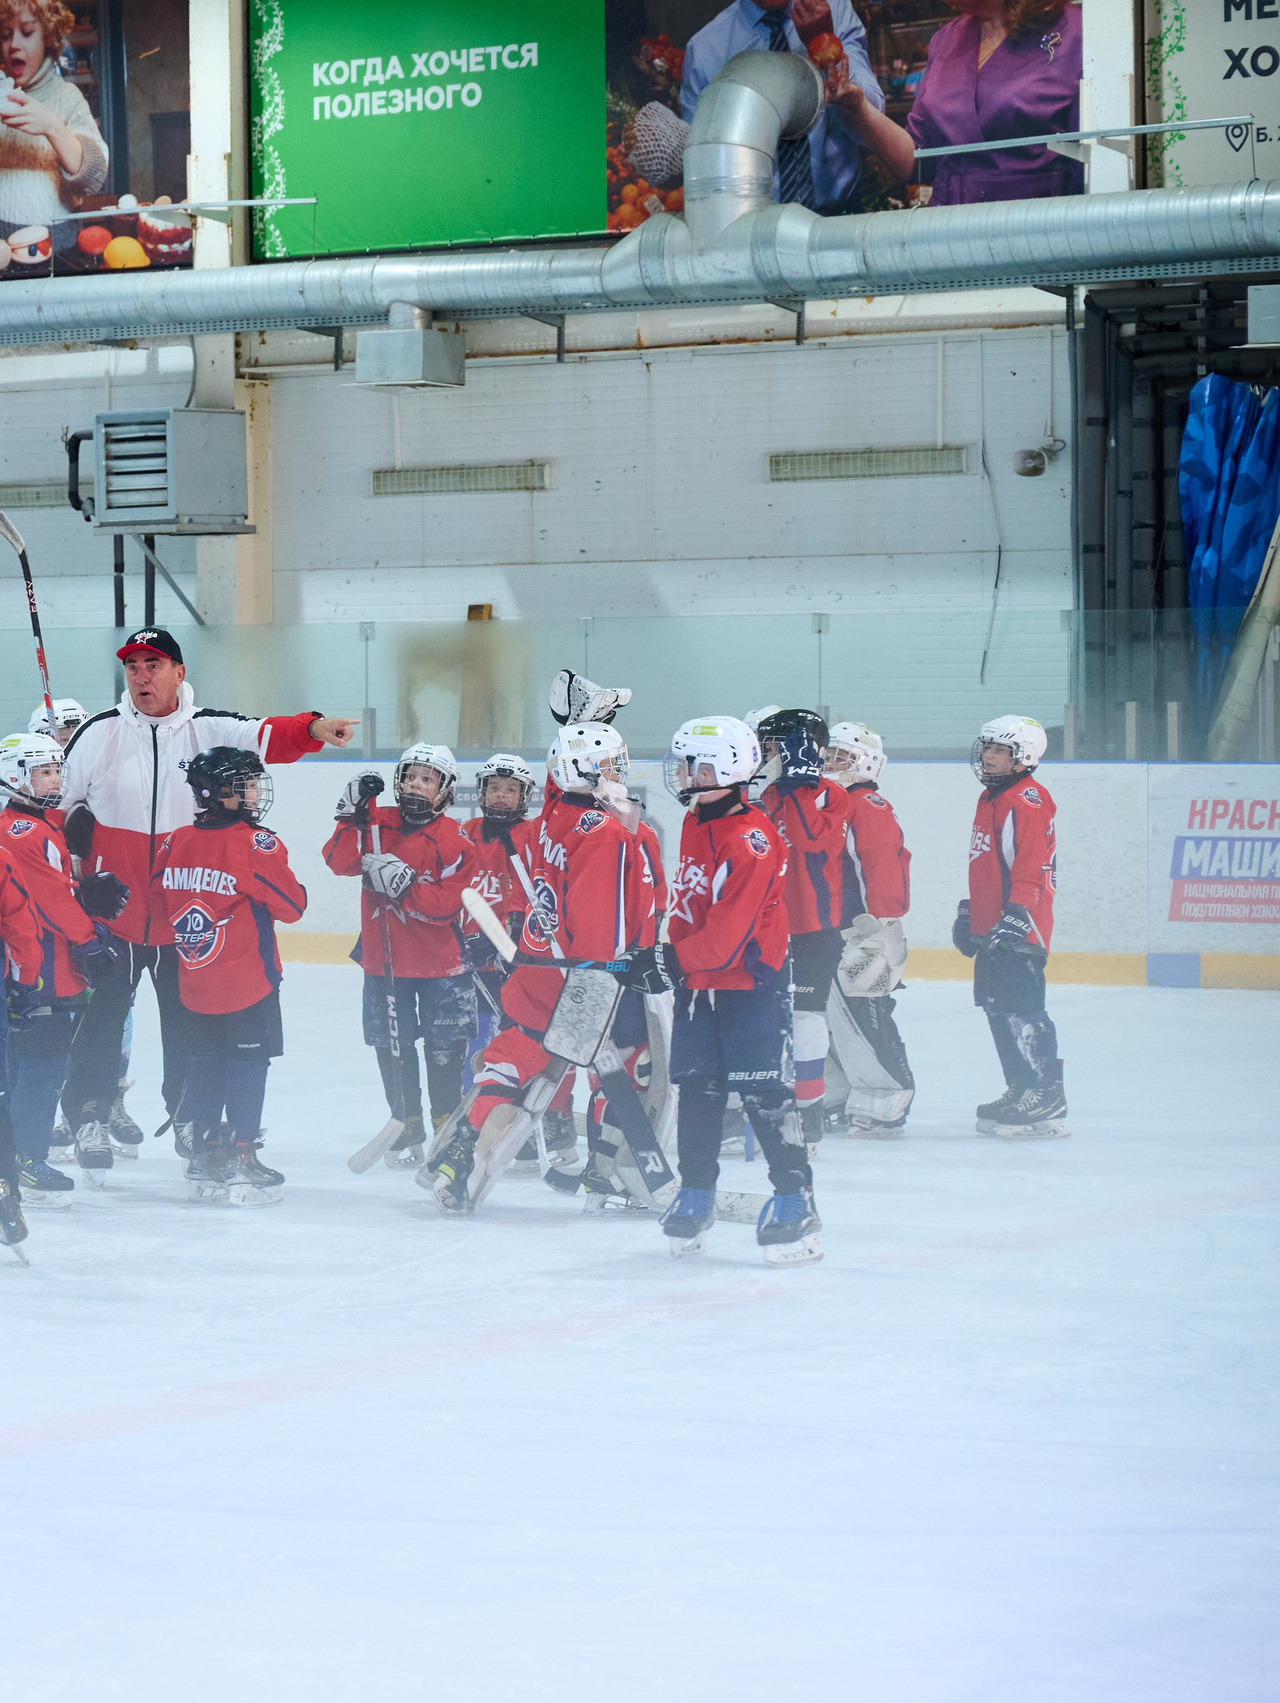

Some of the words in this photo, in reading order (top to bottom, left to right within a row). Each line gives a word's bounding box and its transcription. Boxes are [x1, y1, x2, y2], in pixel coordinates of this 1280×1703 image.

[312, 54, 404, 87] КОГДА
[411, 42, 539, 77] ХОЧЕТСЯ
[313, 82, 482, 120] ПОЛЕЗНОГО
[1181, 840, 1280, 877] МАШИ
[174, 930, 214, 943] STEPS
[186, 913, 204, 931] 10
[606, 960, 630, 972] BAU
[654, 944, 676, 990] BAUER
[386, 994, 400, 1057] CCM
[727, 1070, 779, 1081] BAUER
